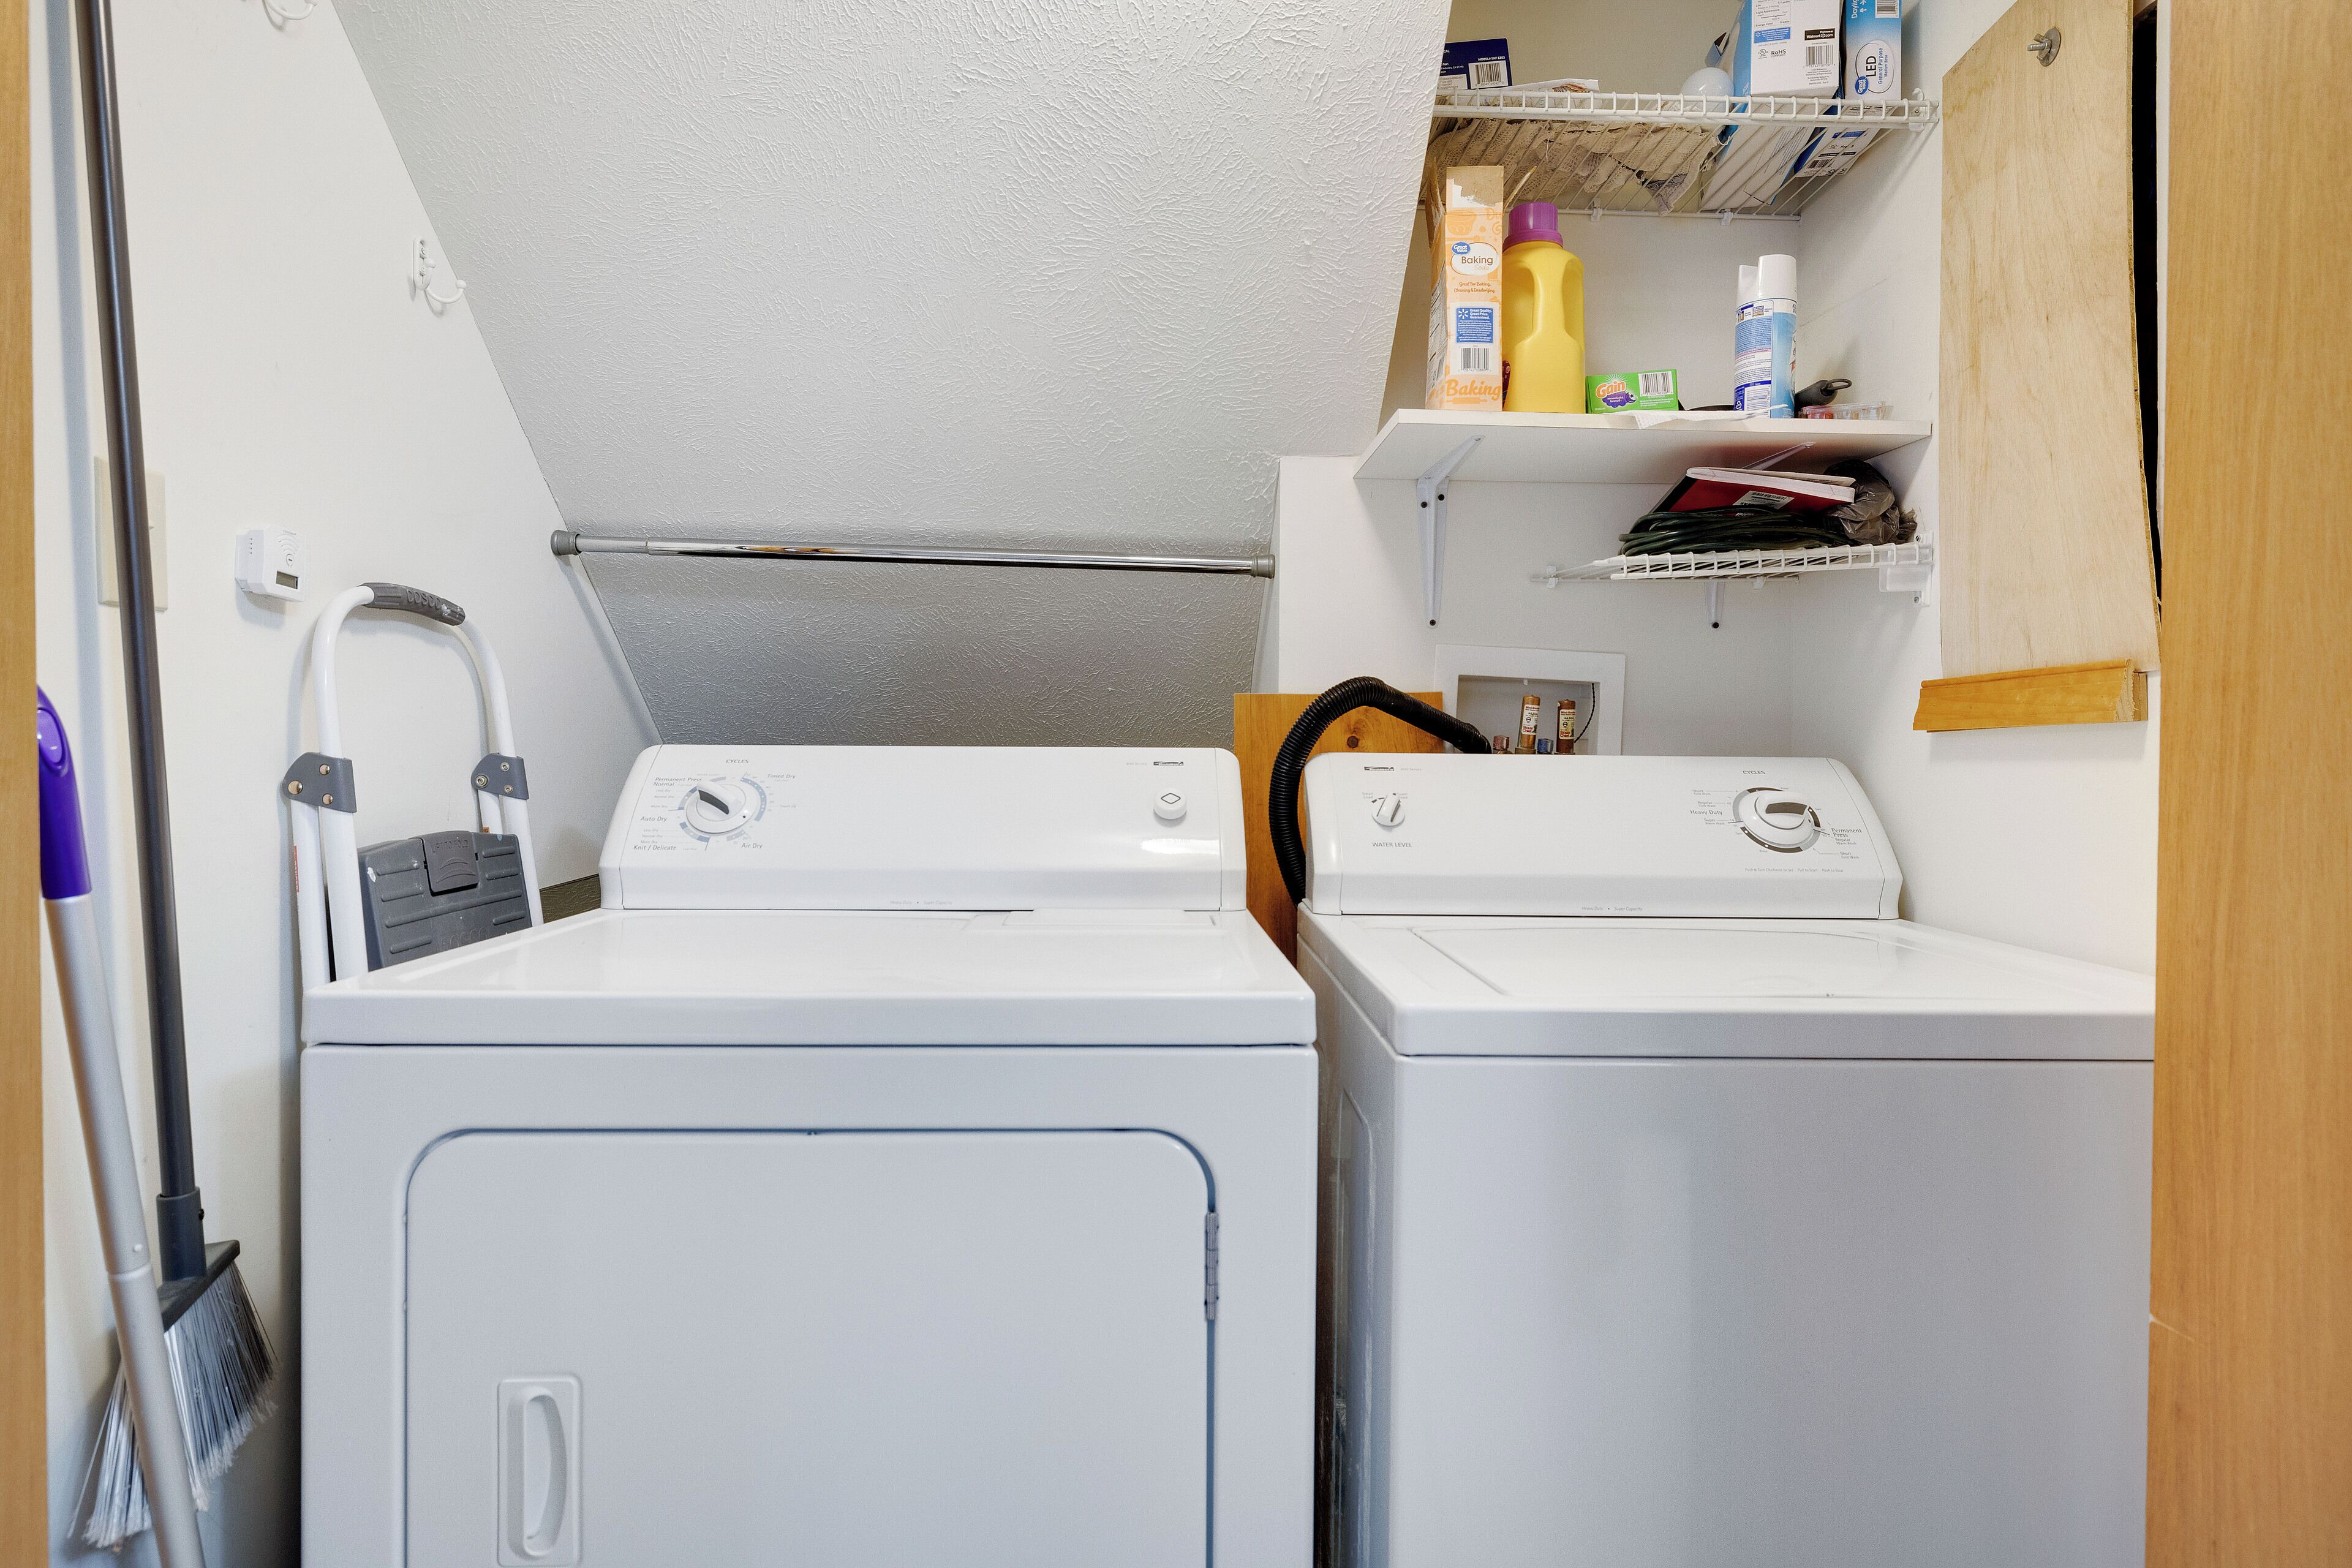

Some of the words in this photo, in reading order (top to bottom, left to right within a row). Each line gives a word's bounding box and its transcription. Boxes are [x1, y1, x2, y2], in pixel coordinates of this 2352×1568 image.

[1866, 56, 1876, 77] LED
[1461, 256, 1493, 265] Baking
[1446, 379, 1501, 401] Baking
[1596, 381, 1626, 398] Gain
[406, 588, 442, 609] COSCO
[431, 842, 442, 854] LIFT
[445, 840, 452, 850] TO
[454, 839, 469, 849] FOLD
